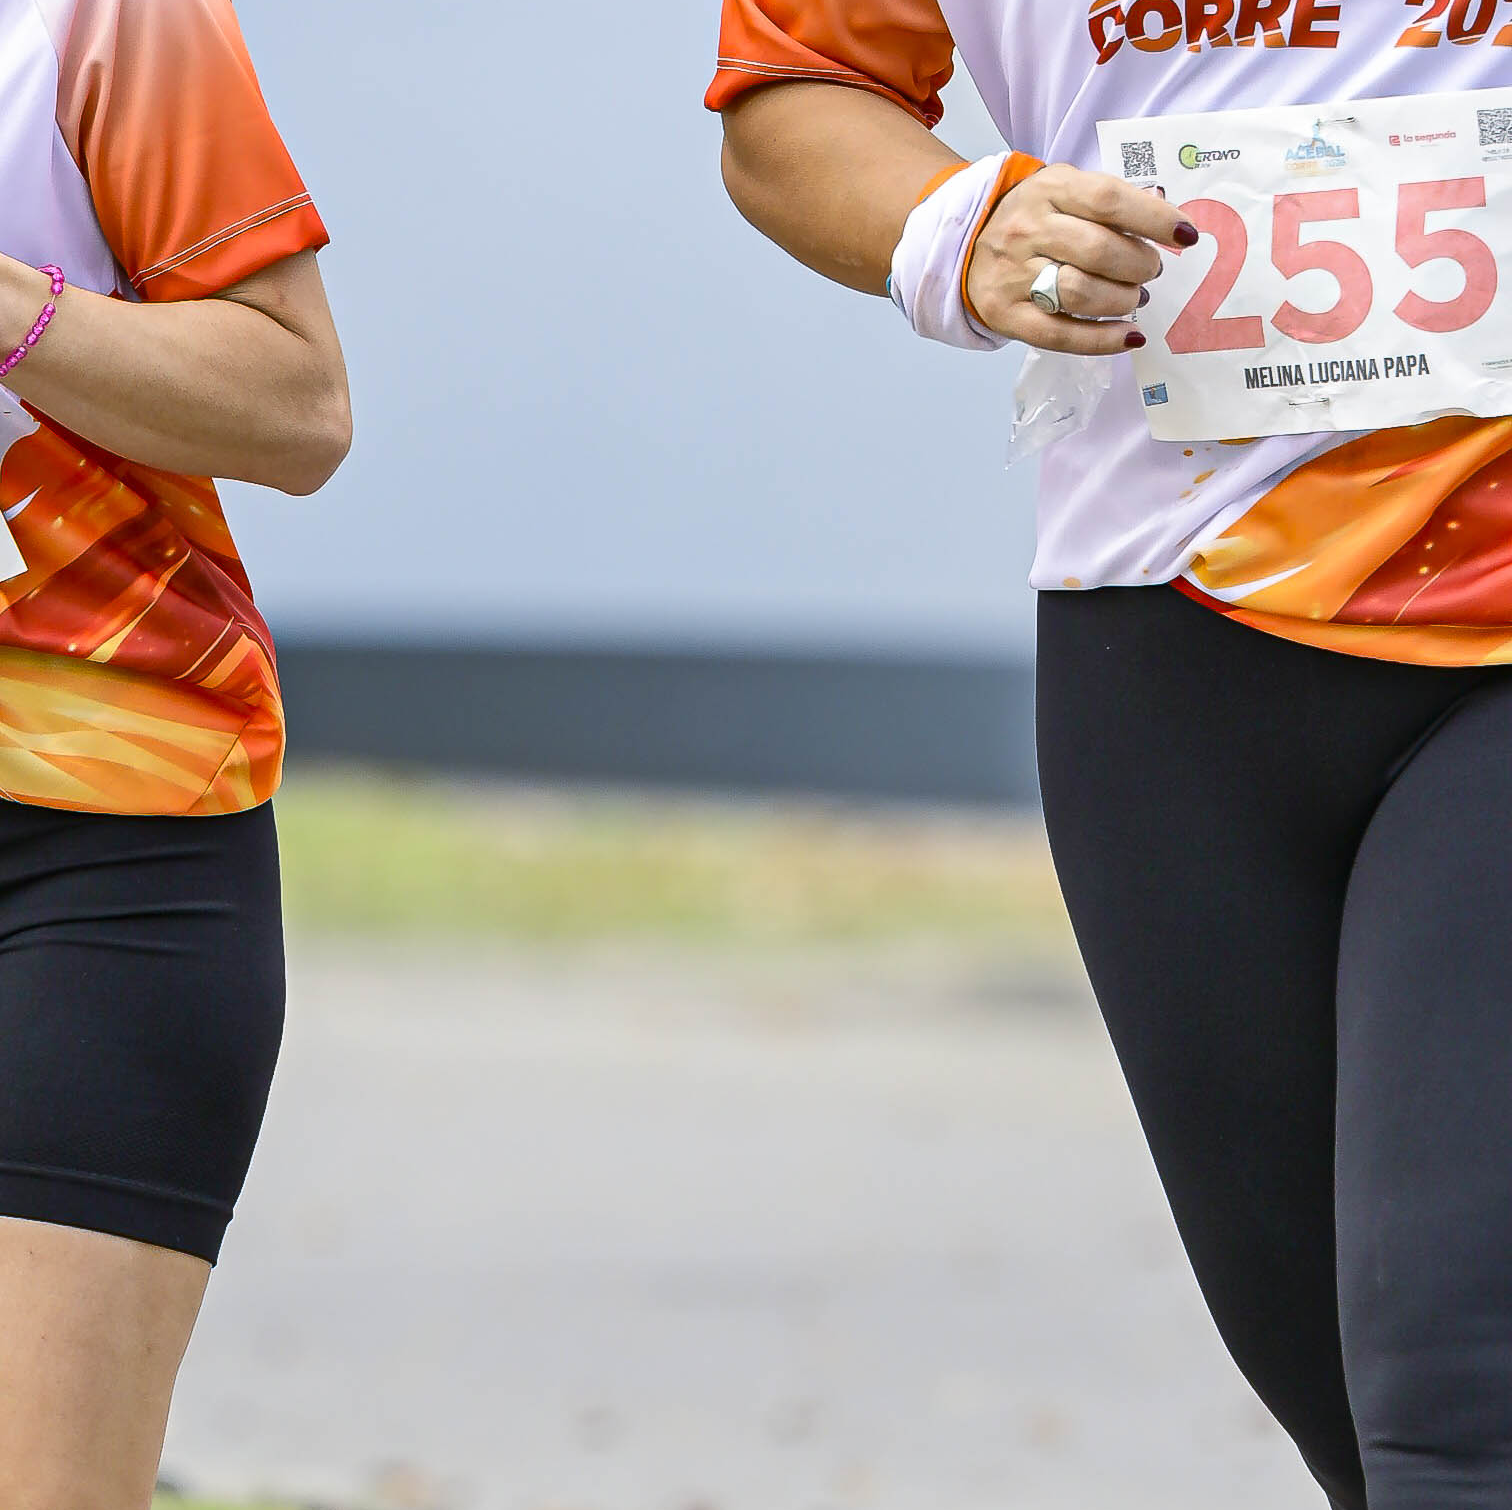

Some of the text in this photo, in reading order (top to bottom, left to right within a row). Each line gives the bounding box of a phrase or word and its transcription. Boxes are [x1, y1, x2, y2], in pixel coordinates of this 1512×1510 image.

[1155, 176, 1498, 354] 255
[1244, 353, 1430, 390] MELINA LUCIANA PAPA
